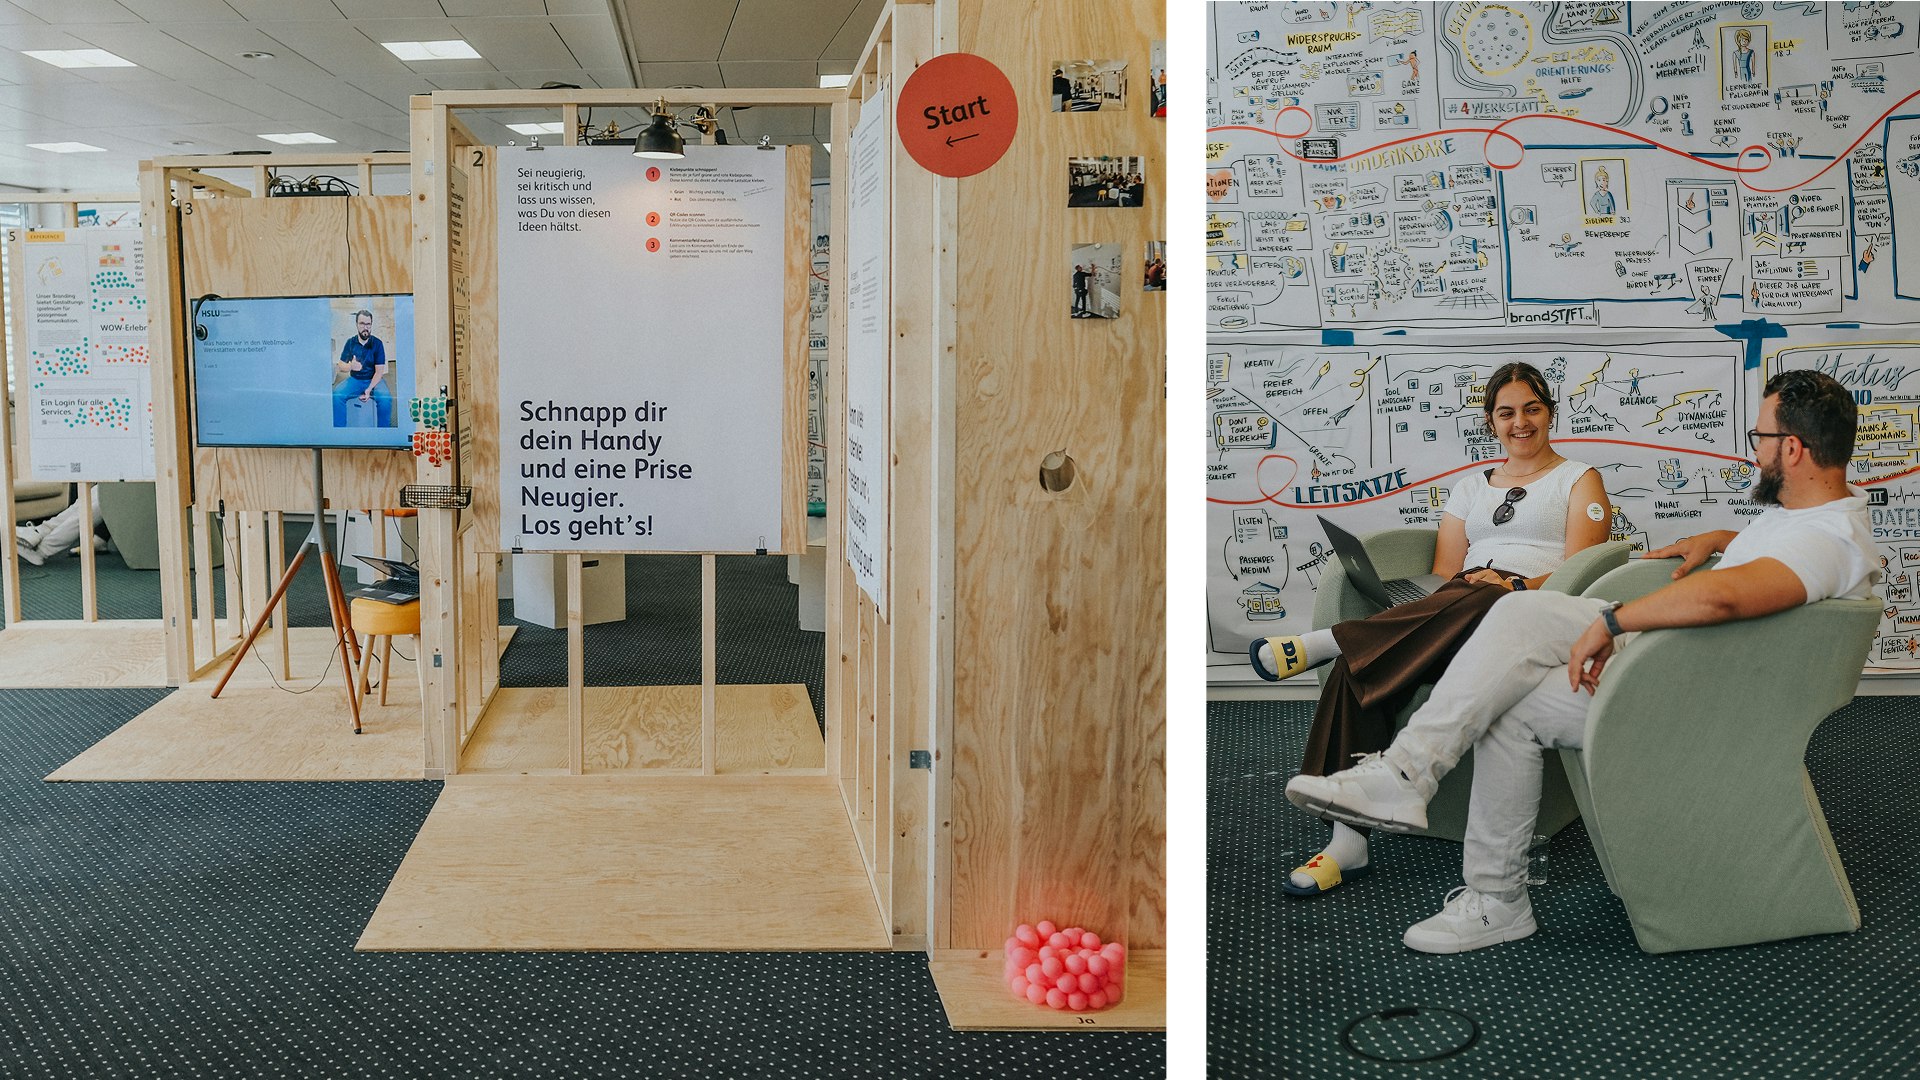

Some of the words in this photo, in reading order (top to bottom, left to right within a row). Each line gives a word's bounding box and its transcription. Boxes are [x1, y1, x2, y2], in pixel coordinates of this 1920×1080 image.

[1636, 21, 1649, 35] WEG
[1653, 7, 1668, 19] ZUM
[1646, 36, 1668, 54] LEADS
[1671, 14, 1717, 38] GENERATION
[1308, 44, 1332, 54] RAUM
[1774, 40, 1794, 50] ELLA
[1656, 59, 1676, 69] LOGIN
[1656, 66, 1700, 79] MEHRWERT
[924, 96, 990, 130] Start
[1472, 102, 1539, 114] WERKSTATT
[1714, 118, 1736, 126] KENNT
[472, 150, 484, 167] 2
[518, 168, 533, 178] Sei
[535, 168, 586, 180] neugierig,
[518, 182, 532, 191] sei
[534, 181, 570, 191] kritisch
[572, 181, 592, 191] und
[518, 195, 537, 205] lass
[539, 197, 557, 205] uns
[560, 195, 595, 206] wissen,
[185, 203, 194, 216] 3
[518, 210, 538, 218] was
[540, 209, 554, 218] Du
[558, 210, 576, 218] von
[578, 208, 611, 218] diesen
[518, 222, 548, 232] Ideen
[550, 222, 582, 232] hältst.
[8, 232, 16, 242] 5
[1626, 280, 1654, 289] HÜRDEN
[1760, 282, 1783, 290] DIESER
[1786, 282, 1799, 290] JOB
[1244, 360, 1274, 369] KREATIV
[1263, 379, 1294, 388] FREIER
[1266, 388, 1303, 398] BEREICH
[54, 400, 76, 408] Login
[1378, 396, 1415, 406] LANDSCHAFT
[1620, 396, 1658, 406] BALANCE
[520, 400, 626, 428] Schnapp
[634, 401, 668, 422] dir
[1678, 410, 1728, 422] DYNAMISCHE
[1228, 417, 1248, 426] DONT
[1571, 416, 1592, 424] FESTE
[1571, 424, 1614, 434] ELEMENTE
[1682, 421, 1724, 430] ELEMENTEN
[1857, 424, 1880, 433] MAINS
[1857, 430, 1906, 441] SUBDOMAINS
[520, 430, 572, 450] dein
[582, 430, 662, 456] Handy
[1309, 446, 1332, 466] GRENZE
[520, 458, 566, 479] und
[574, 459, 626, 479] eine
[634, 458, 692, 480] Prise
[1295, 468, 1412, 504] LEITSÄTZE
[521, 486, 624, 512] Neugier.
[1399, 506, 1429, 514] WICHTIGE
[1655, 501, 1680, 509] INHALT
[1654, 510, 1702, 520] PERSONALISIERT
[1872, 508, 1920, 528] DATE
[522, 514, 560, 535] Los
[1238, 517, 1263, 526] LISTEN
[1239, 556, 1275, 564] PASSENDES
[1240, 566, 1270, 575] MEDIUM
[1281, 640, 1299, 671] DL
[1076, 1017, 1096, 1025] Ja
